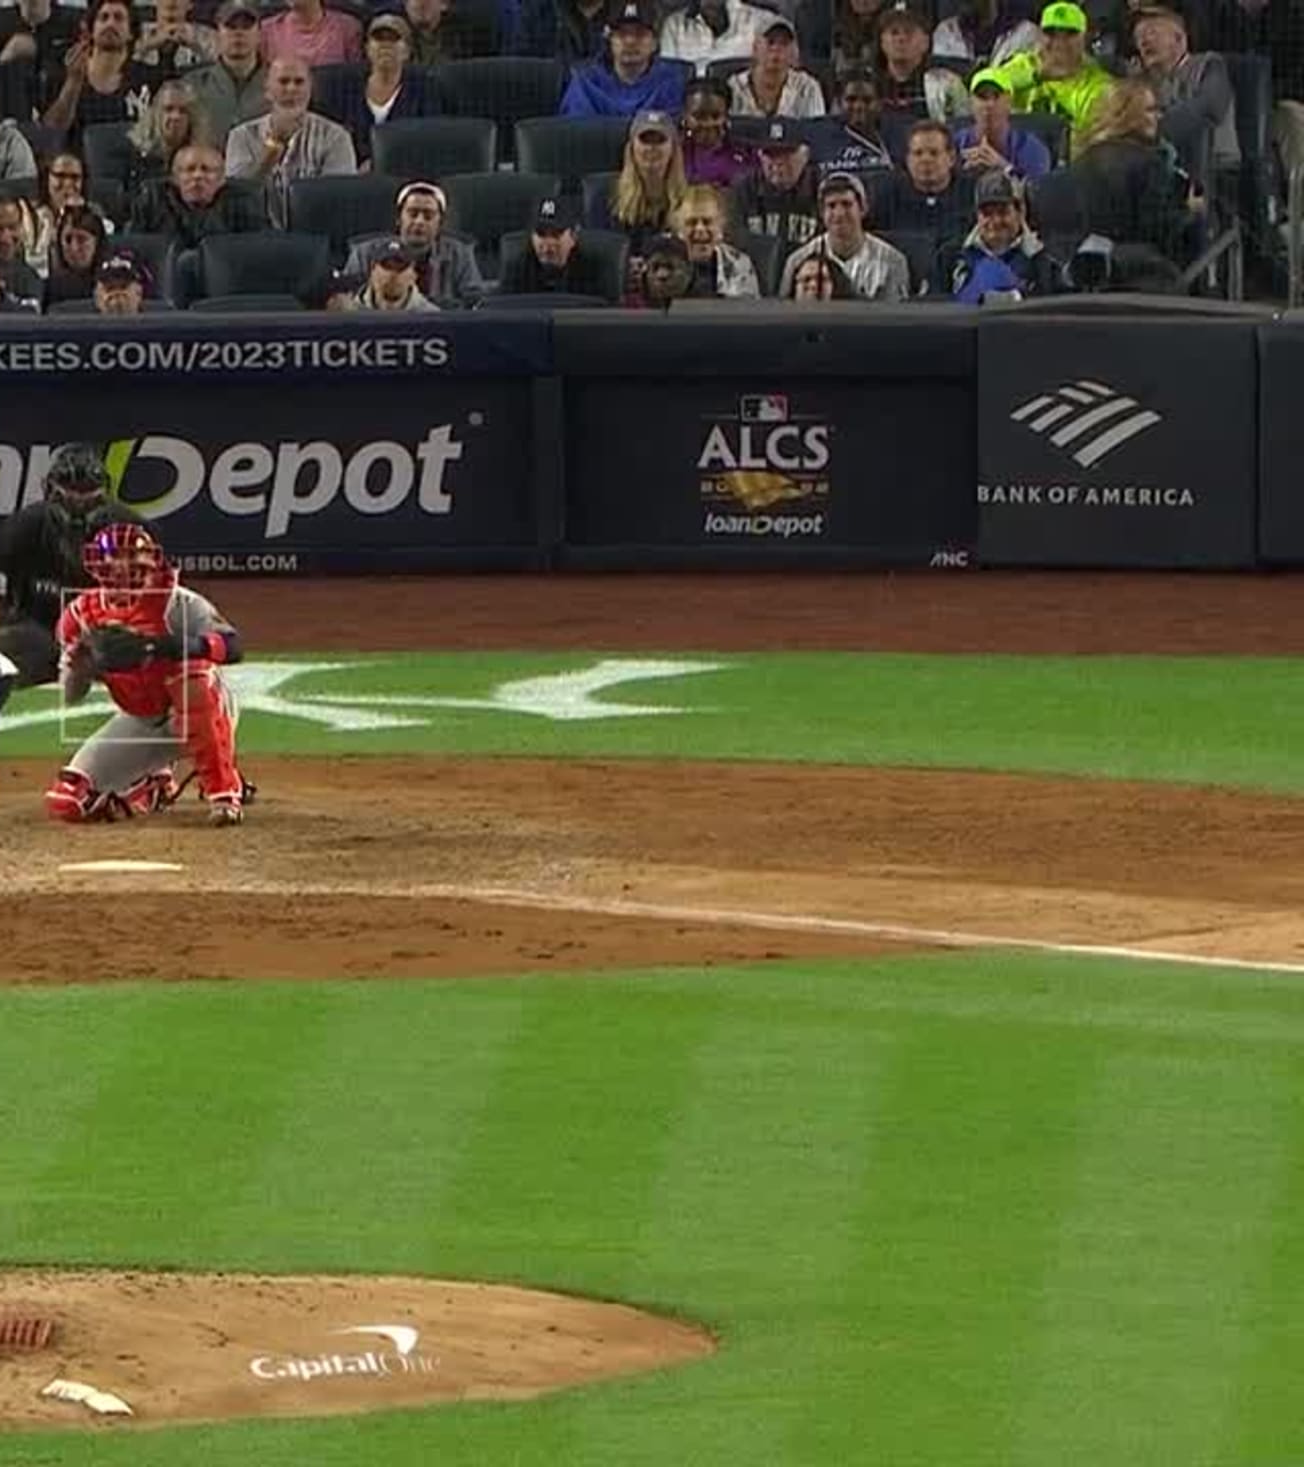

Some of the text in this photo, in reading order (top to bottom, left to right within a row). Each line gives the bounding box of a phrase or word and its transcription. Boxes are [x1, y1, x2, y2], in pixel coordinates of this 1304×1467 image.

[698, 424, 829, 469] ALCS
[977, 485, 1194, 506] BANK OF AMERICA
[705, 513, 822, 537] loanDepot
